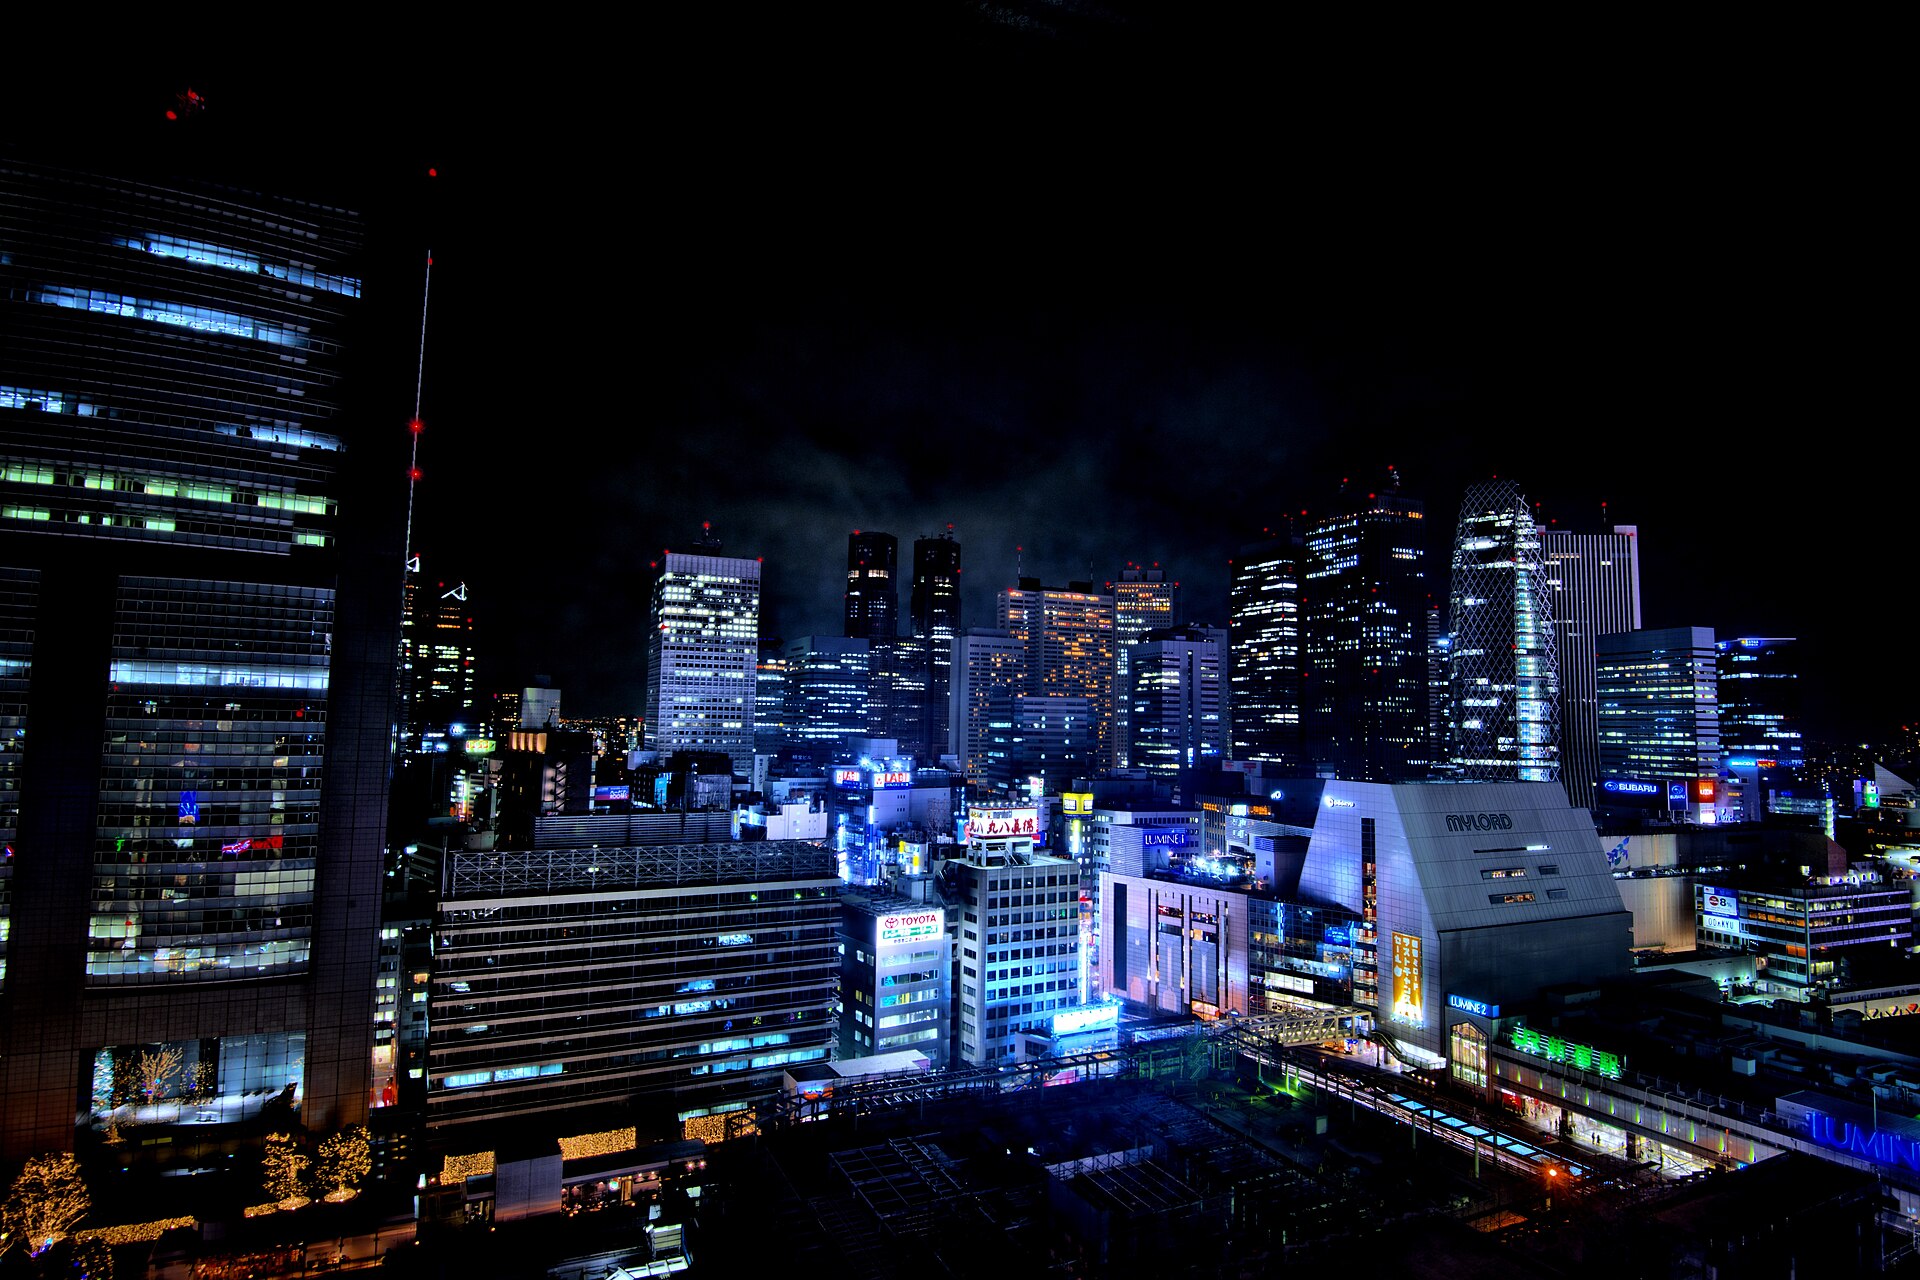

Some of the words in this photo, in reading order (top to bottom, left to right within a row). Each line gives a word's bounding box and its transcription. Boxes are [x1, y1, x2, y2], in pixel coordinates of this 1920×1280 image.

[1618, 783, 1657, 793] SUBARU
[1445, 813, 1513, 832] MYLORD
[1145, 833, 1179, 845] LUMINE
[901, 915, 936, 925] TOYOTA
[1450, 995, 1481, 1014] LUMINE
[1481, 1004, 1488, 1015] 2
[1811, 1109, 1920, 1172] LUMIN
